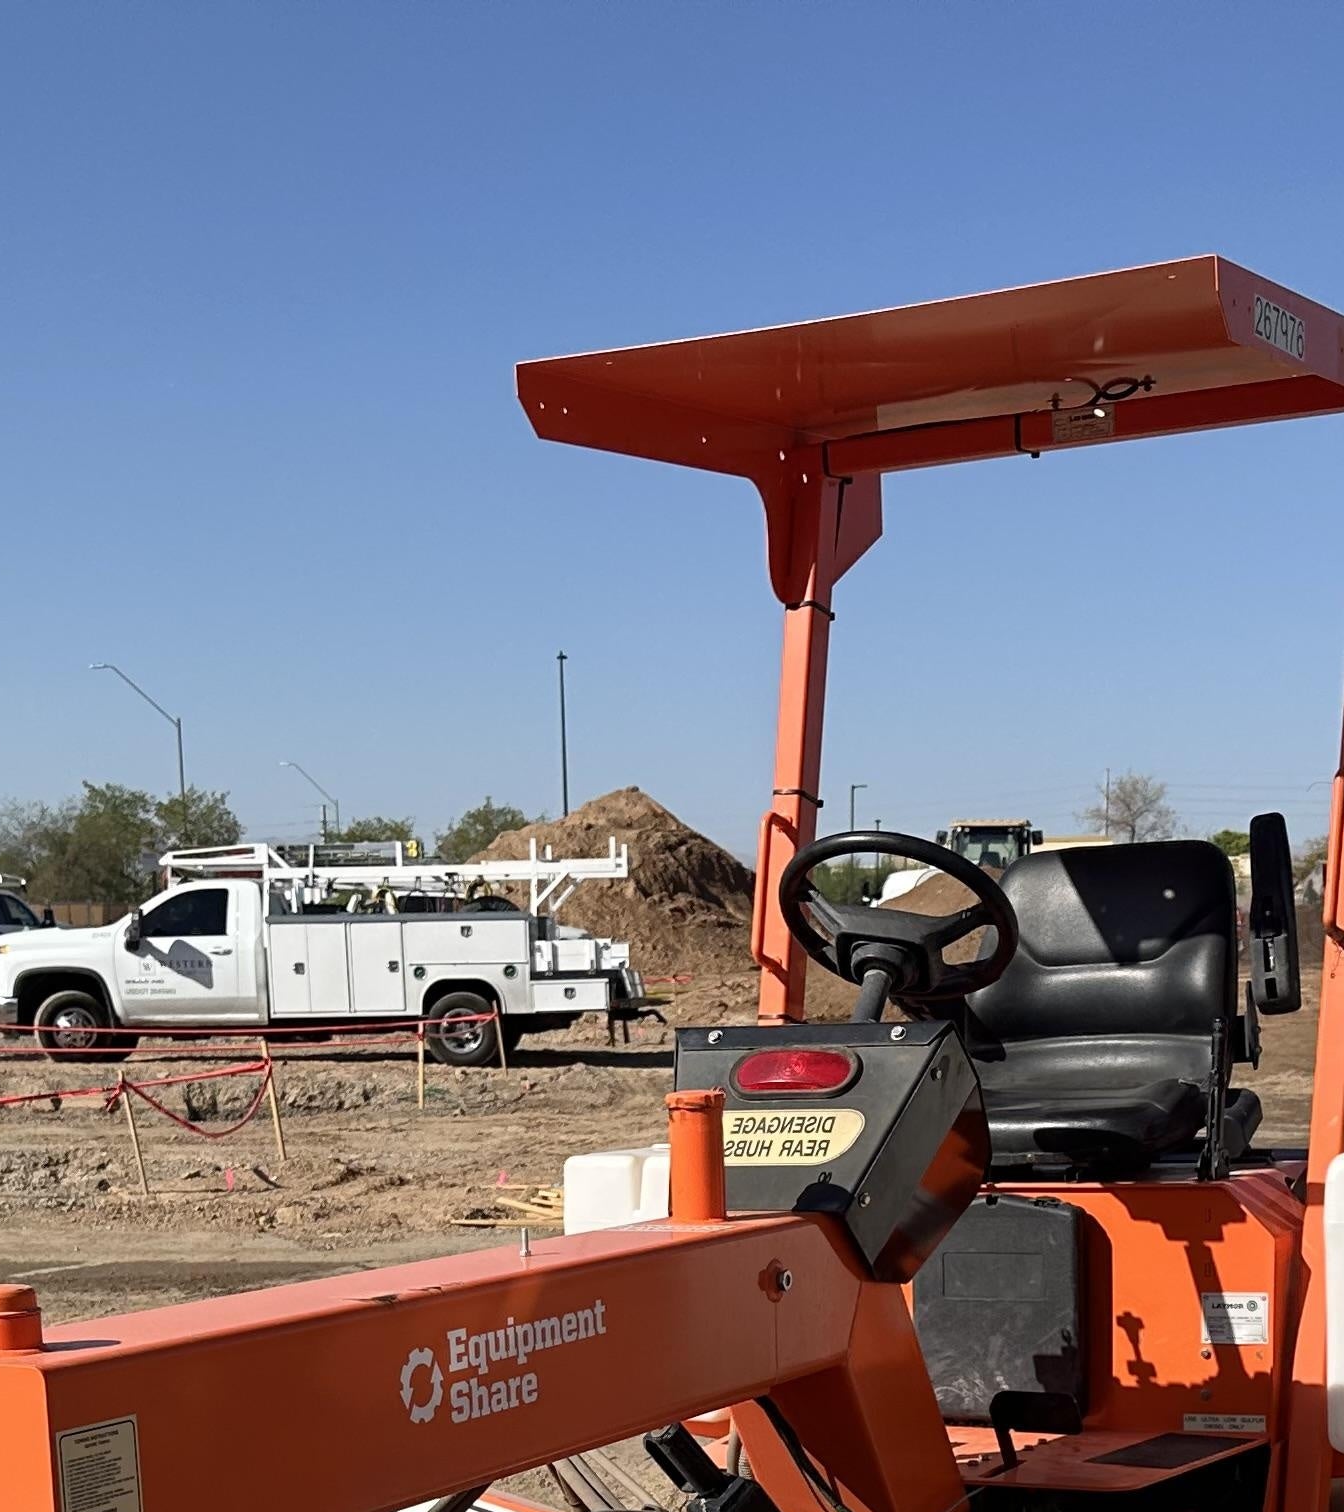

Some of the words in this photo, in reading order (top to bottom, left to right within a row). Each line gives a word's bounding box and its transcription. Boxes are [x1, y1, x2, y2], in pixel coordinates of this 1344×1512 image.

[1256, 297, 1304, 358] 267976
[447, 1300, 606, 1374] Equipment
[450, 1372, 538, 1424] Share
